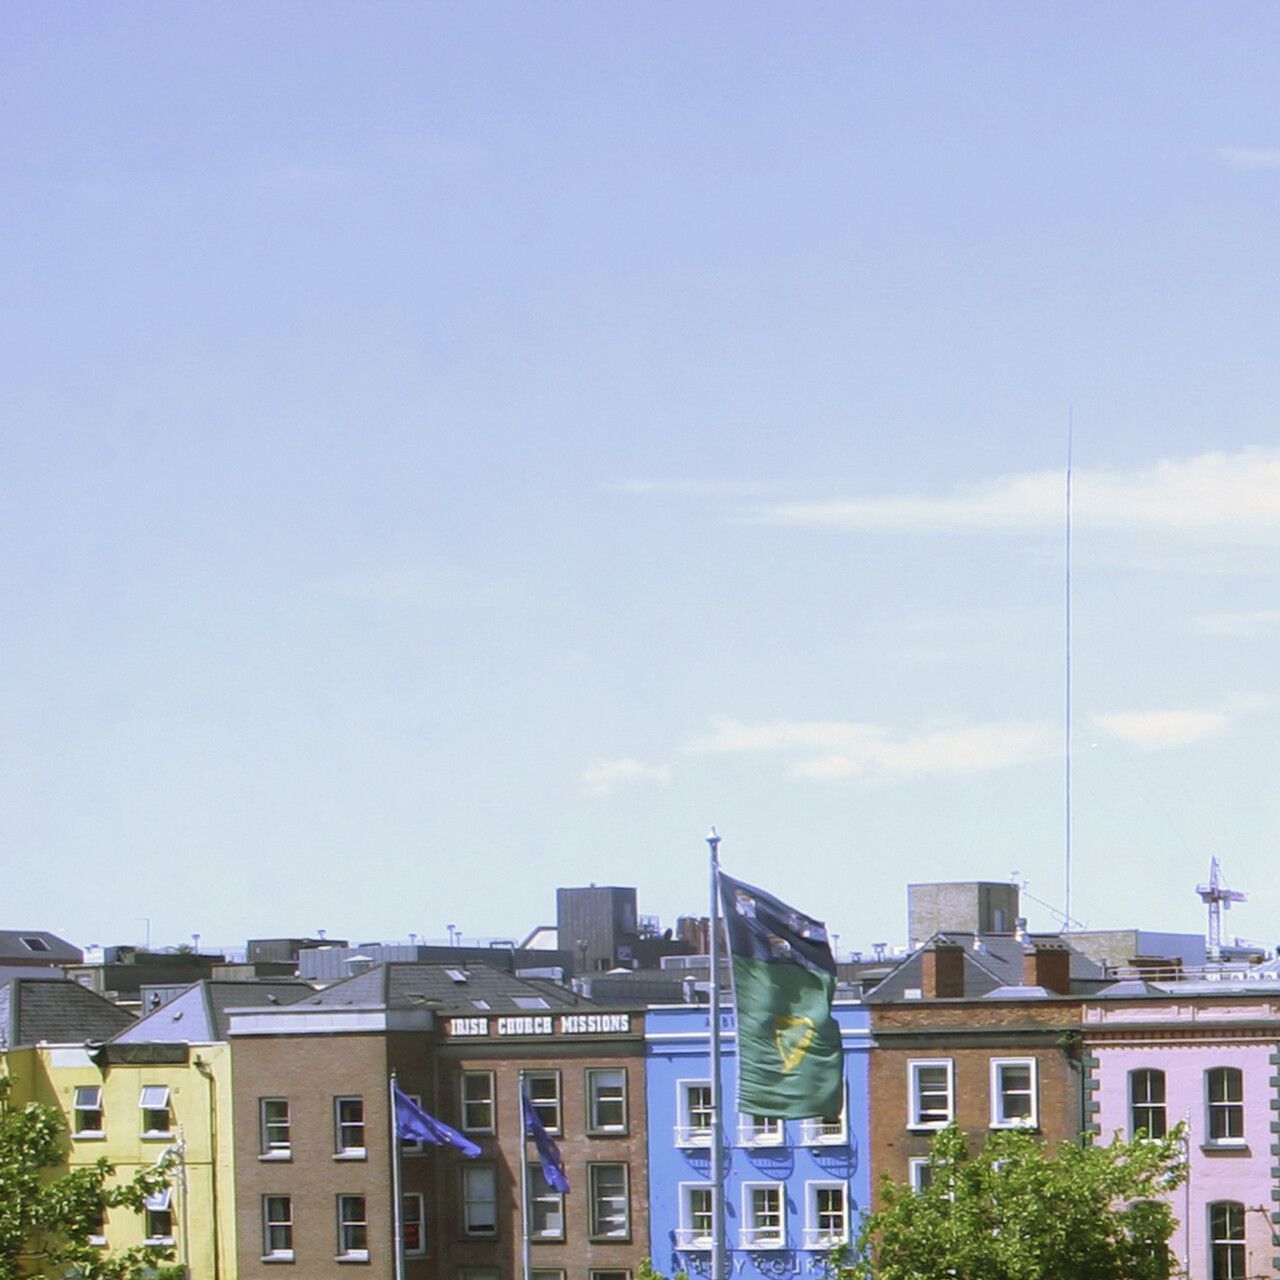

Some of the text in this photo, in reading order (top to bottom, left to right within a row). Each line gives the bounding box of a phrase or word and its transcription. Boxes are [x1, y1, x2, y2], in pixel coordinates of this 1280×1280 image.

[450, 1014, 630, 1036] IRISH CHURCH MISSIONS
